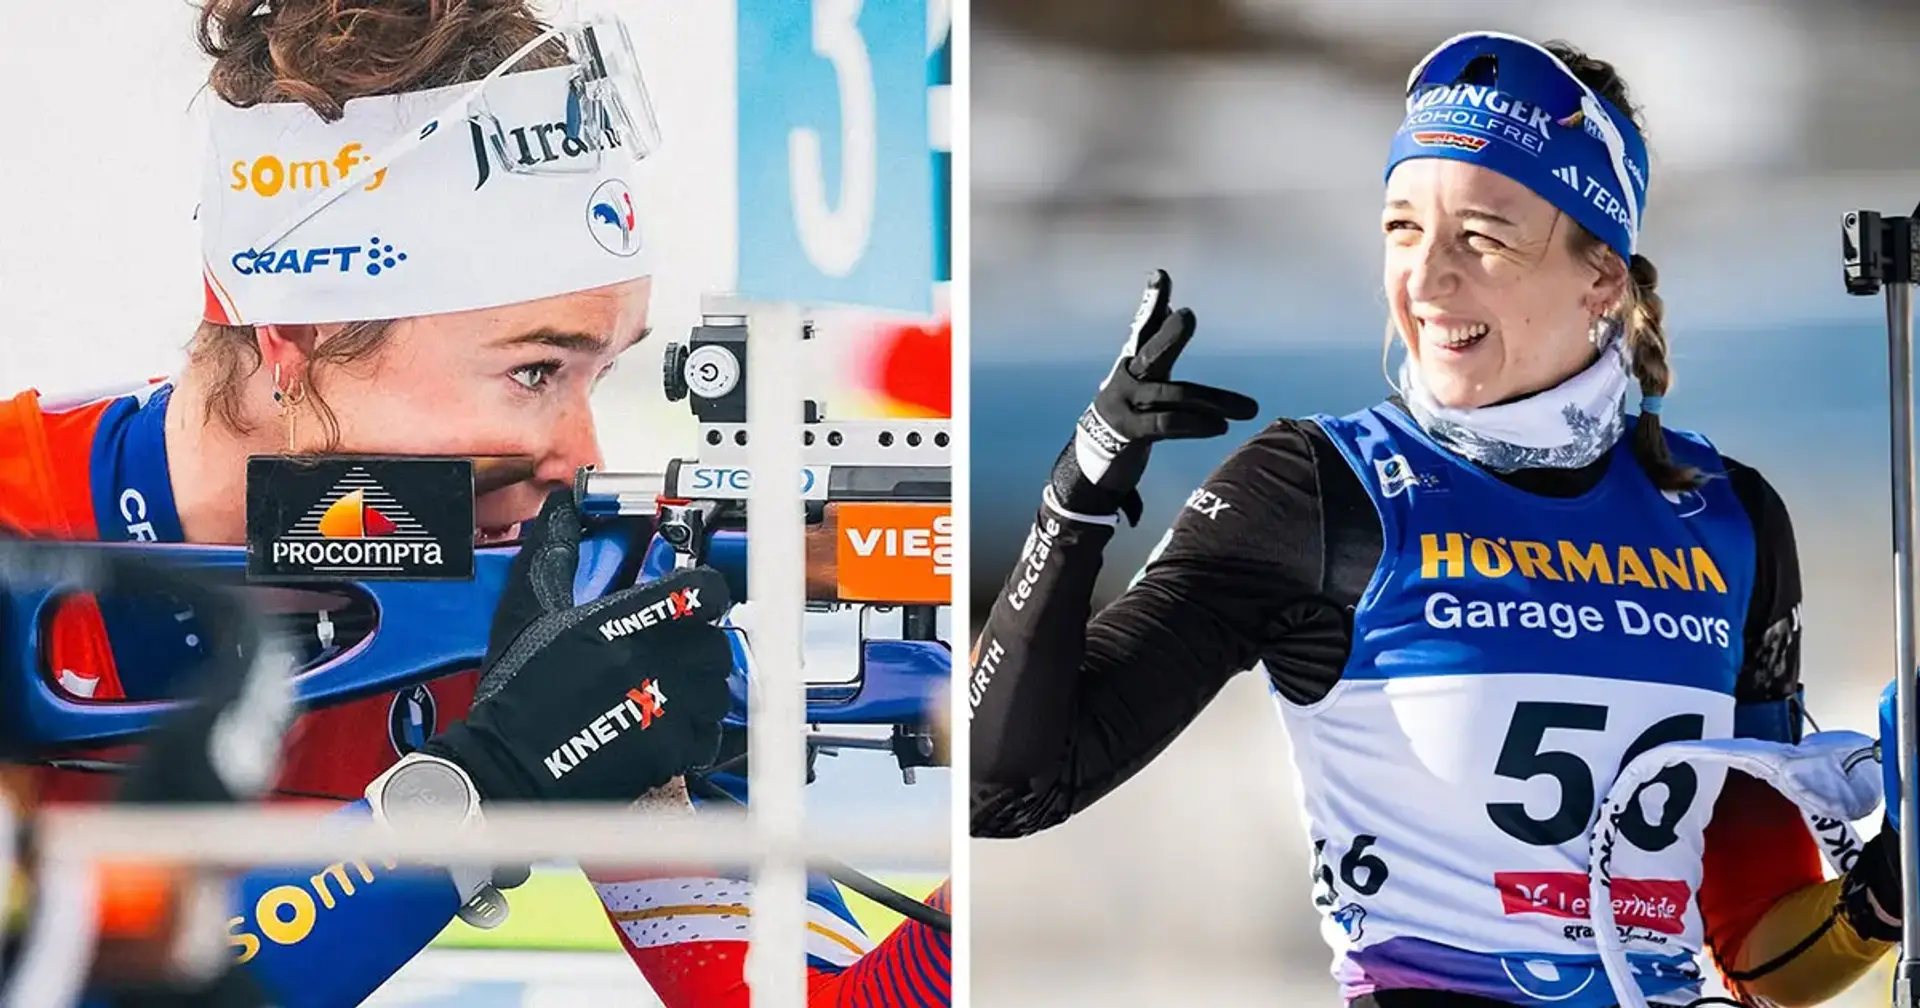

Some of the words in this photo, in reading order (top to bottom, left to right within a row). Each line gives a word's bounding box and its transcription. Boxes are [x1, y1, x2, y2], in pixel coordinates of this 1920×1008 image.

[787, 0, 877, 278] 3
[1583, 175, 1632, 240] TERR
[232, 246, 362, 275] CRAFT
[1008, 517, 1060, 611] tectake
[599, 586, 702, 641] KINETIXX
[1424, 592, 1605, 639] Garage
[1614, 599, 1731, 649] Doors
[543, 678, 668, 780] KINETIXX
[1486, 700, 1705, 852] 56
[225, 855, 397, 963] som
